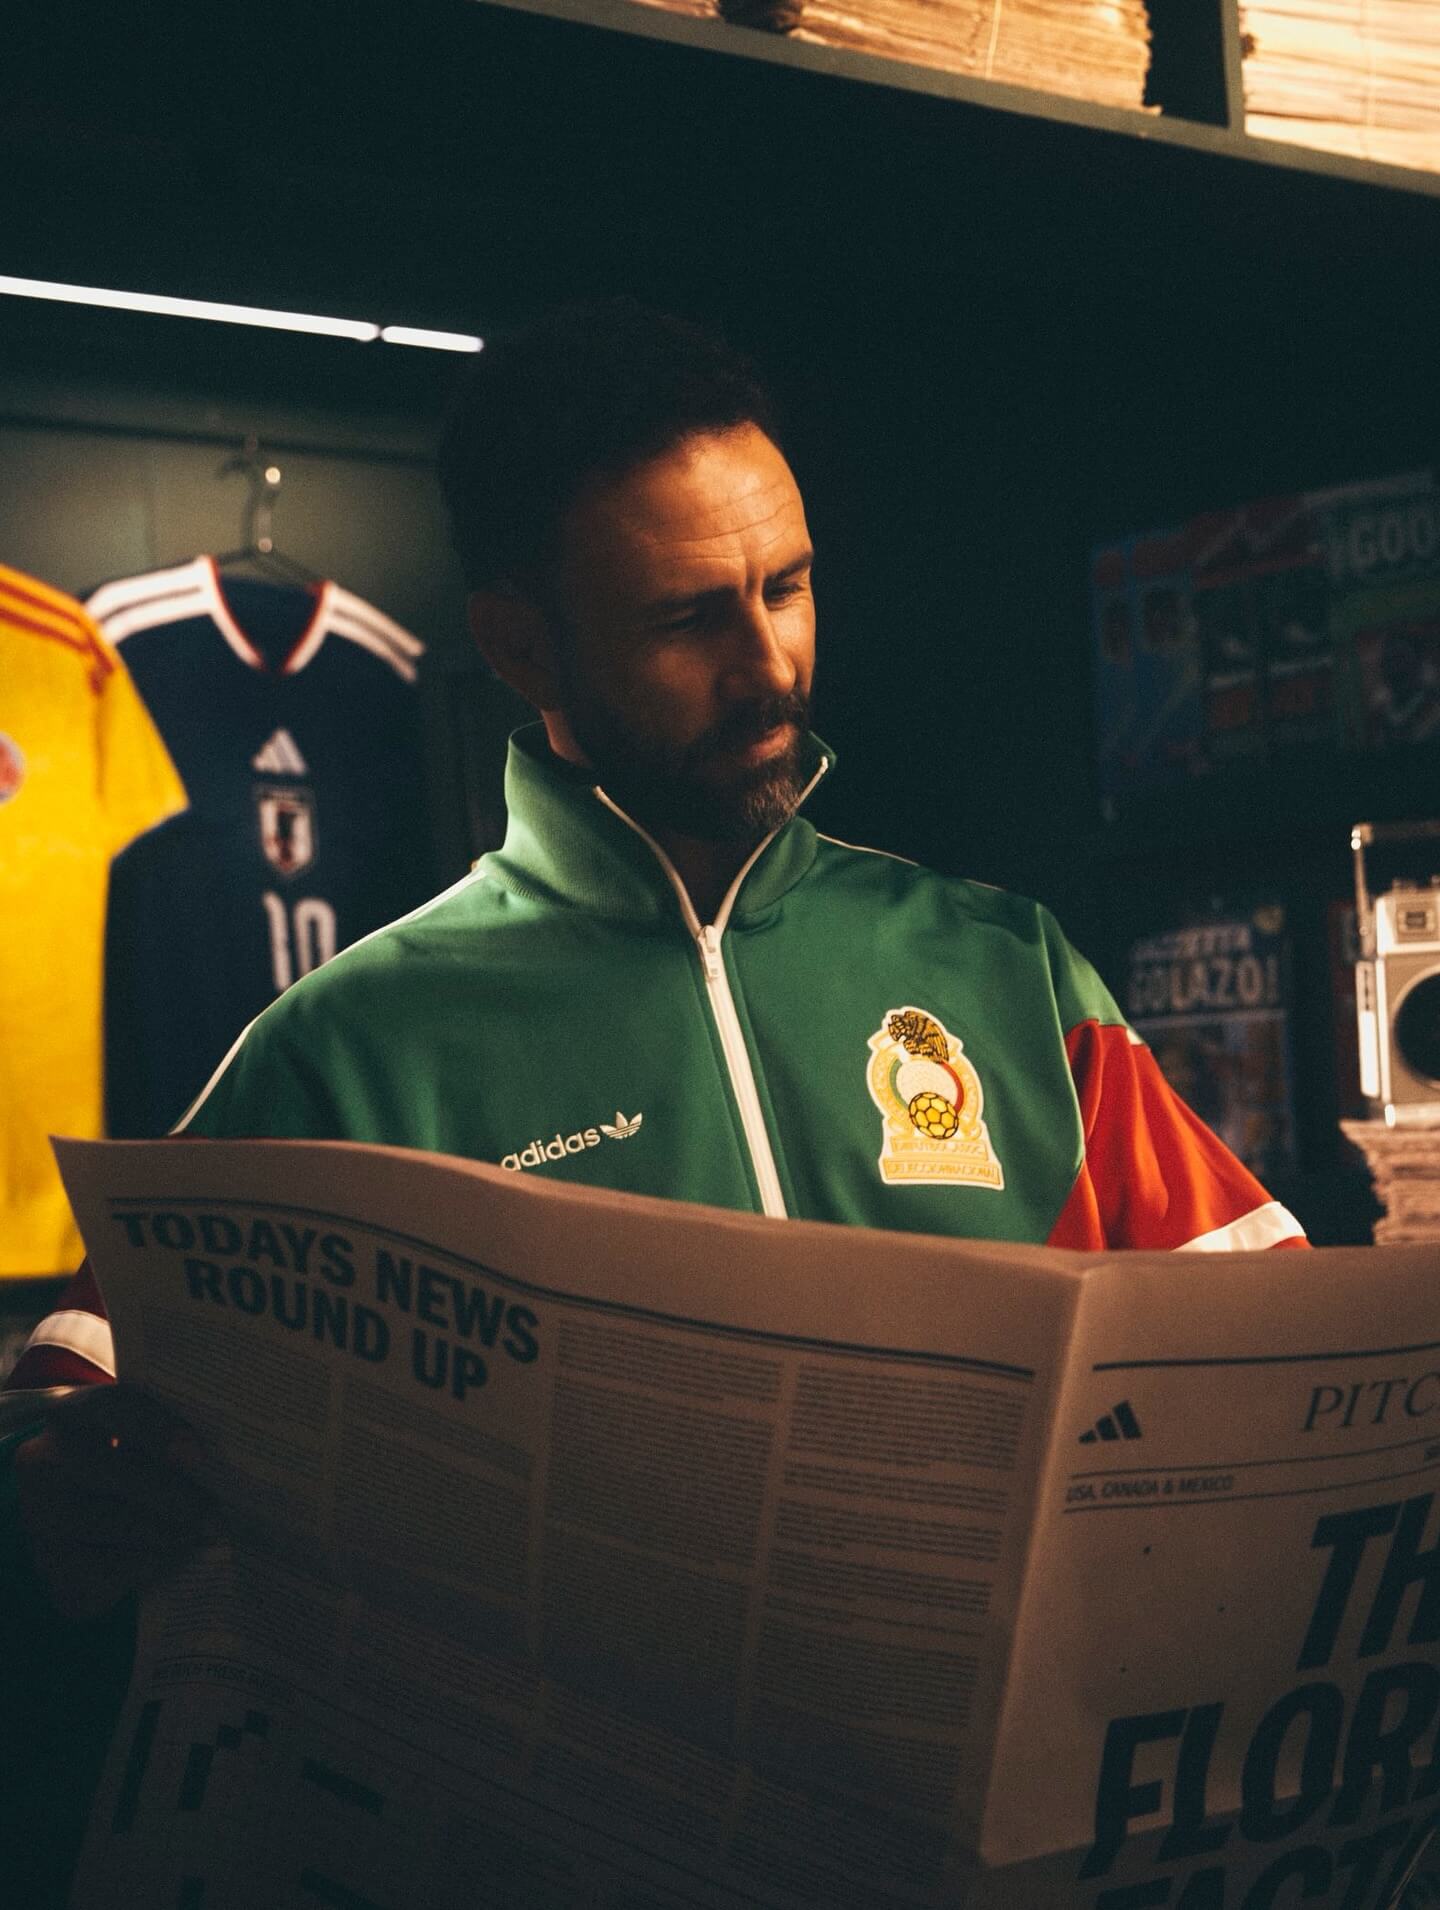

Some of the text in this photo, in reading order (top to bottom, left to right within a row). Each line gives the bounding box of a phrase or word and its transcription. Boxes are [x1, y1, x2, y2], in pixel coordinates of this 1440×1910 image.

[262, 890, 337, 992] 10
[501, 1128, 601, 1171] adidas
[112, 1211, 539, 1363] TODAYS NEWS
[184, 1258, 487, 1400] ROUND UP
[1103, 1479, 1158, 1498] CANADA
[1162, 1478, 1173, 1495] &
[1178, 1474, 1234, 1493] MEXICO
